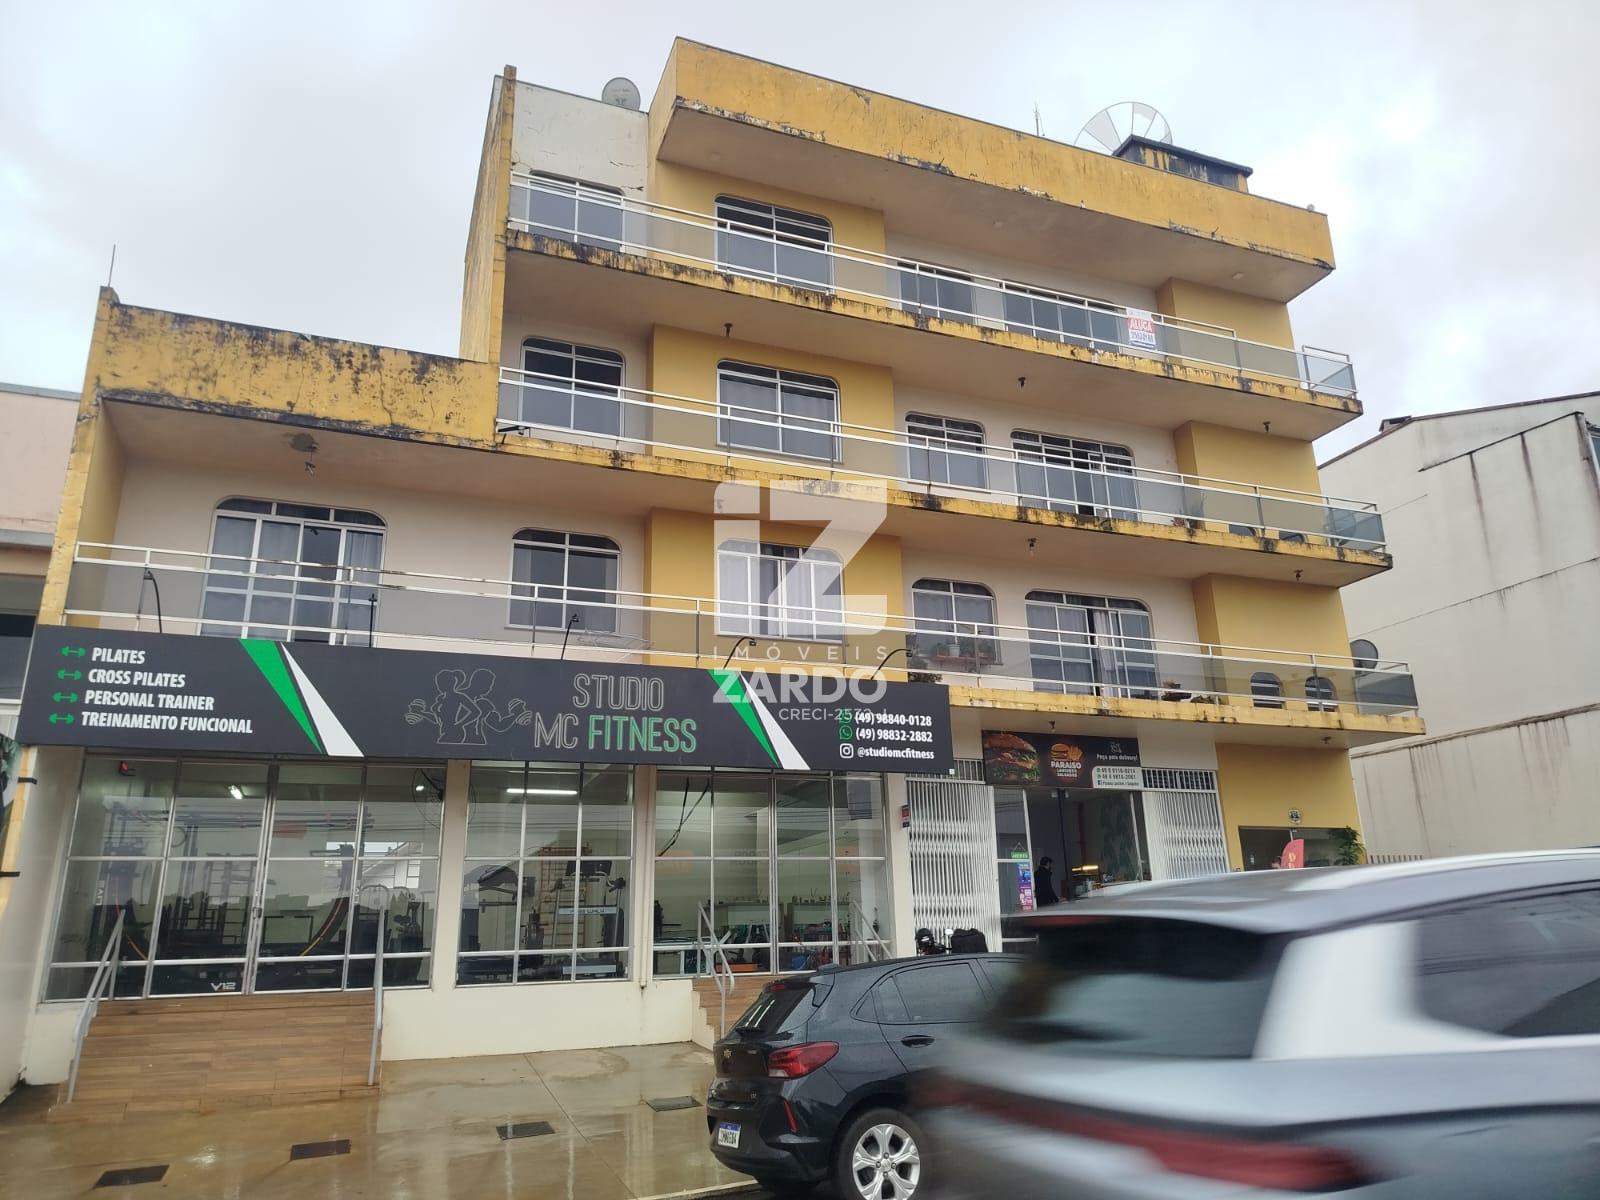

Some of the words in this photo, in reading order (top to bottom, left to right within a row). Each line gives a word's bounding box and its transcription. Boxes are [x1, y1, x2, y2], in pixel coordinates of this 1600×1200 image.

[1129, 318, 1154, 332] ALUGA
[91, 647, 146, 665] PILATES
[88, 668, 131, 685] CROSS
[133, 671, 186, 688] PILATES
[84, 690, 155, 708] PERSONAL
[158, 694, 215, 711] TRAINER
[572, 673, 665, 712] STUDIO
[81, 711, 178, 730] TREINAMENTO
[180, 717, 253, 734] FUNCIONAL
[855, 711, 875, 725] (49)
[876, 713, 932, 727] 98840-0128
[534, 712, 579, 749] MC
[588, 714, 697, 753] FITNESS
[855, 727, 876, 741] (49)
[877, 729, 933, 743] 98832-2882
[857, 746, 935, 760] @studiomcfitness
